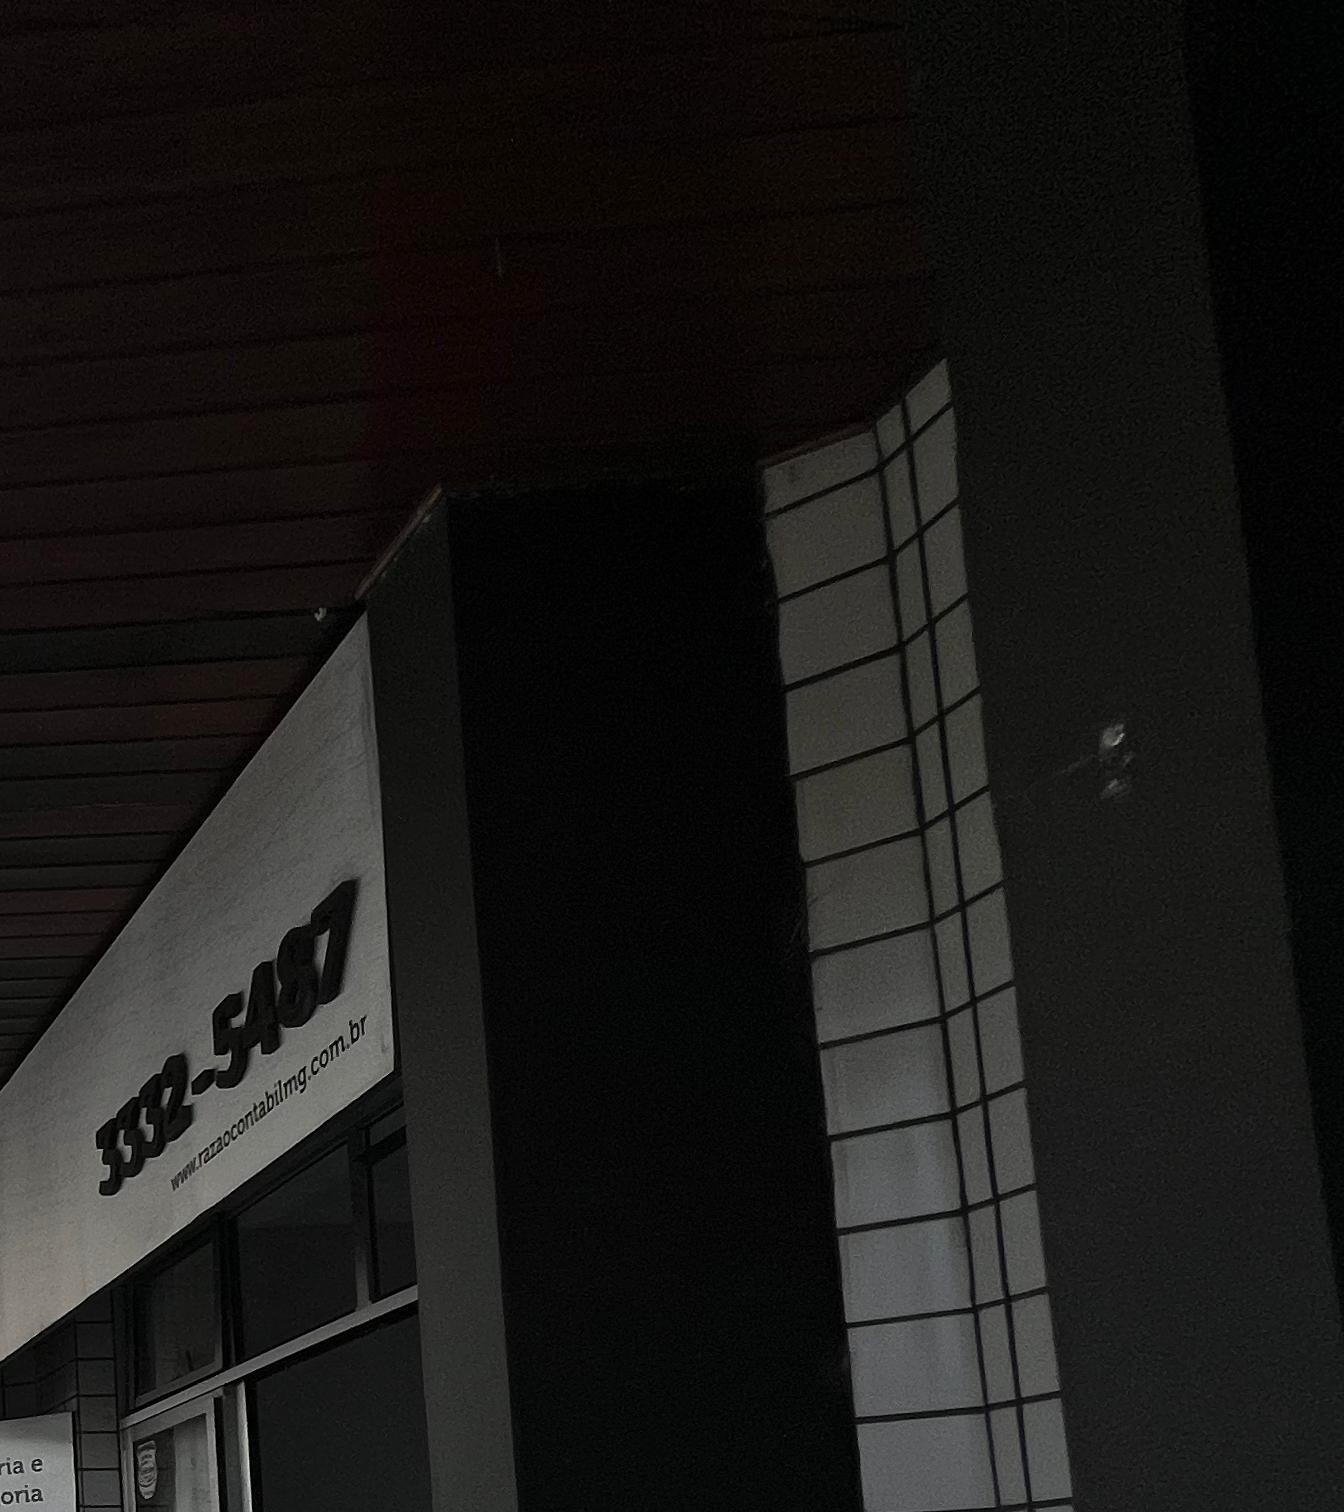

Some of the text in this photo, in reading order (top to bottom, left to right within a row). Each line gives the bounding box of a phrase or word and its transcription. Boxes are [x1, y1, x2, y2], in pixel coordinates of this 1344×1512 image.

[95, 878, 360, 1196] 3332-5487
[171, 1015, 367, 1190] www.razaocontabilmg.com.br
[31, 1458, 44, 1473] e
